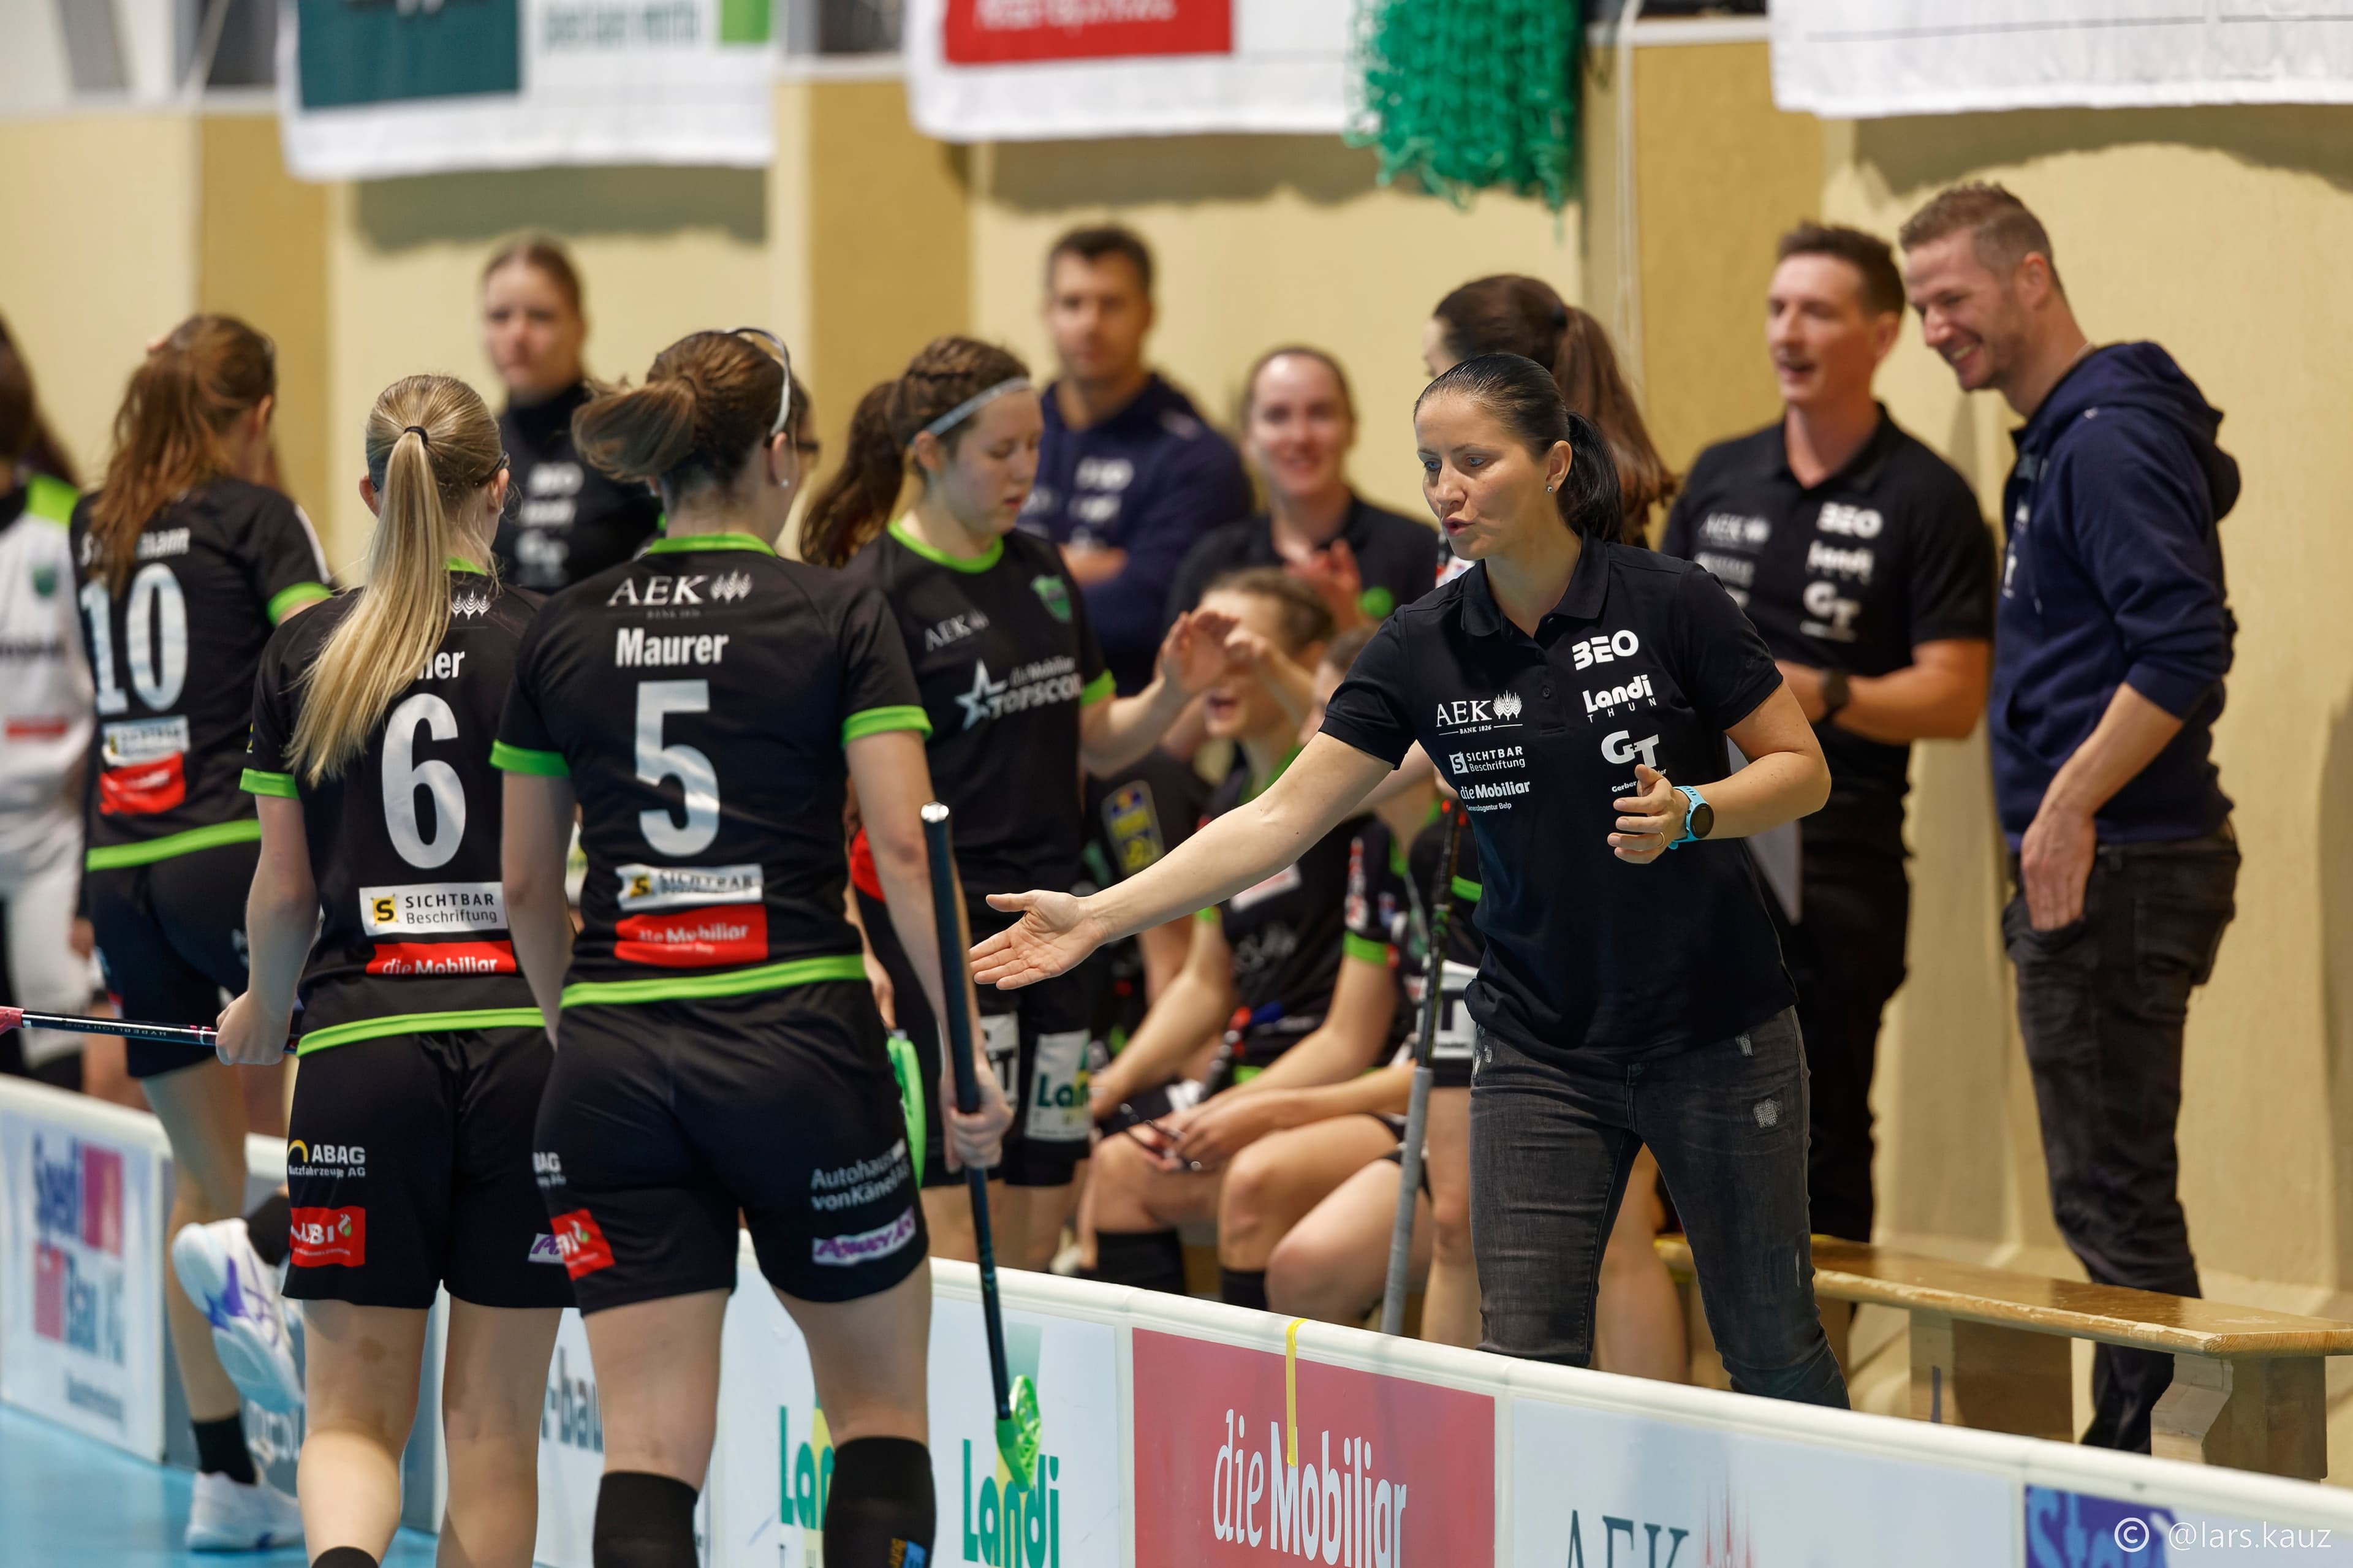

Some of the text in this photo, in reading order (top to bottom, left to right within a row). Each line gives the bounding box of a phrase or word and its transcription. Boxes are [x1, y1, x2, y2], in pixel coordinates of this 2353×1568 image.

[607, 575, 709, 607] AEK
[80, 563, 188, 716] 10
[616, 627, 729, 668] Maurer
[1572, 630, 1639, 670] BEO
[1582, 674, 1653, 713] Landi
[1436, 700, 1492, 727] AEK
[635, 679, 720, 857] 5
[1466, 746, 1523, 762] SICHTBAR
[1469, 759, 1525, 772] Beschriftung
[382, 693, 466, 868] 6
[1612, 781, 1637, 792] Gerber
[405, 893, 494, 909] SICHTBAR
[406, 909, 498, 925] Beschriftung
[311, 1144, 366, 1165] ABAG
[347, 1167, 366, 1177] AG
[963, 1439, 1059, 1568] Landi
